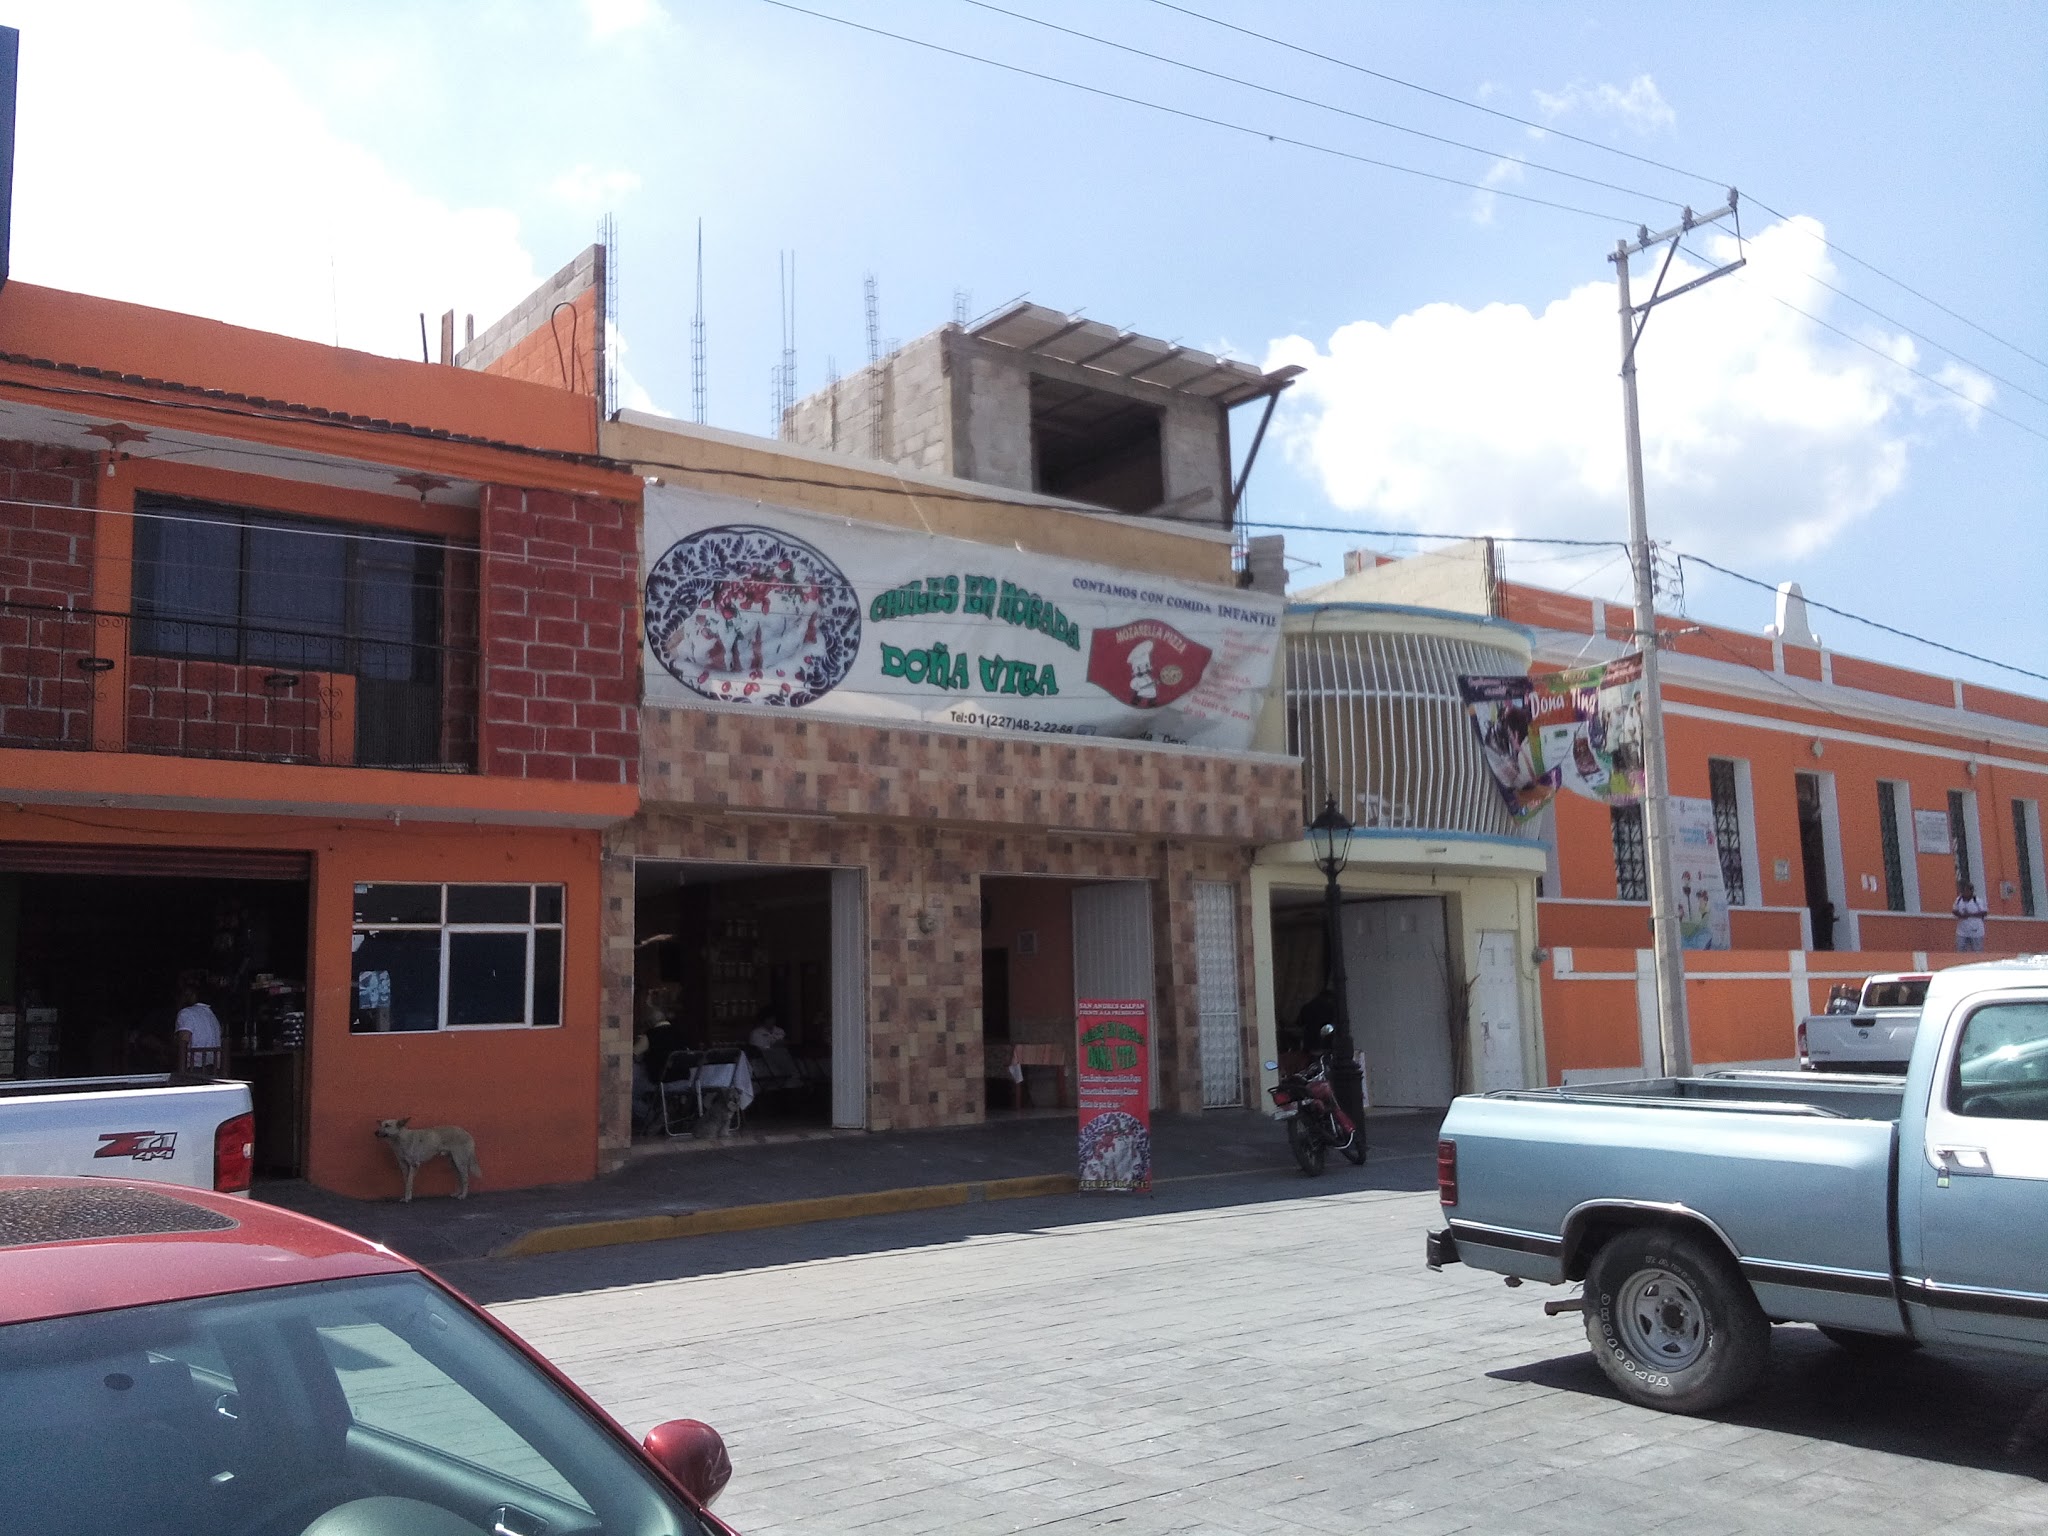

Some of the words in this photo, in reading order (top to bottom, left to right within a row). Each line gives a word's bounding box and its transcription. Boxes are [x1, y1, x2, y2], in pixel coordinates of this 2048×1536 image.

[869, 575, 959, 622] CHILES
[964, 574, 997, 619] EN
[997, 580, 1080, 651] NOGADA
[1072, 577, 1138, 600] CONTAMOS
[1140, 590, 1164, 604] CON
[1166, 596, 1212, 614] COMIDA
[1217, 604, 1276, 628] INFANTIL
[879, 641, 970, 691] DOÑA
[978, 654, 1060, 697] VITA
[93, 1130, 178, 1158] Z71
